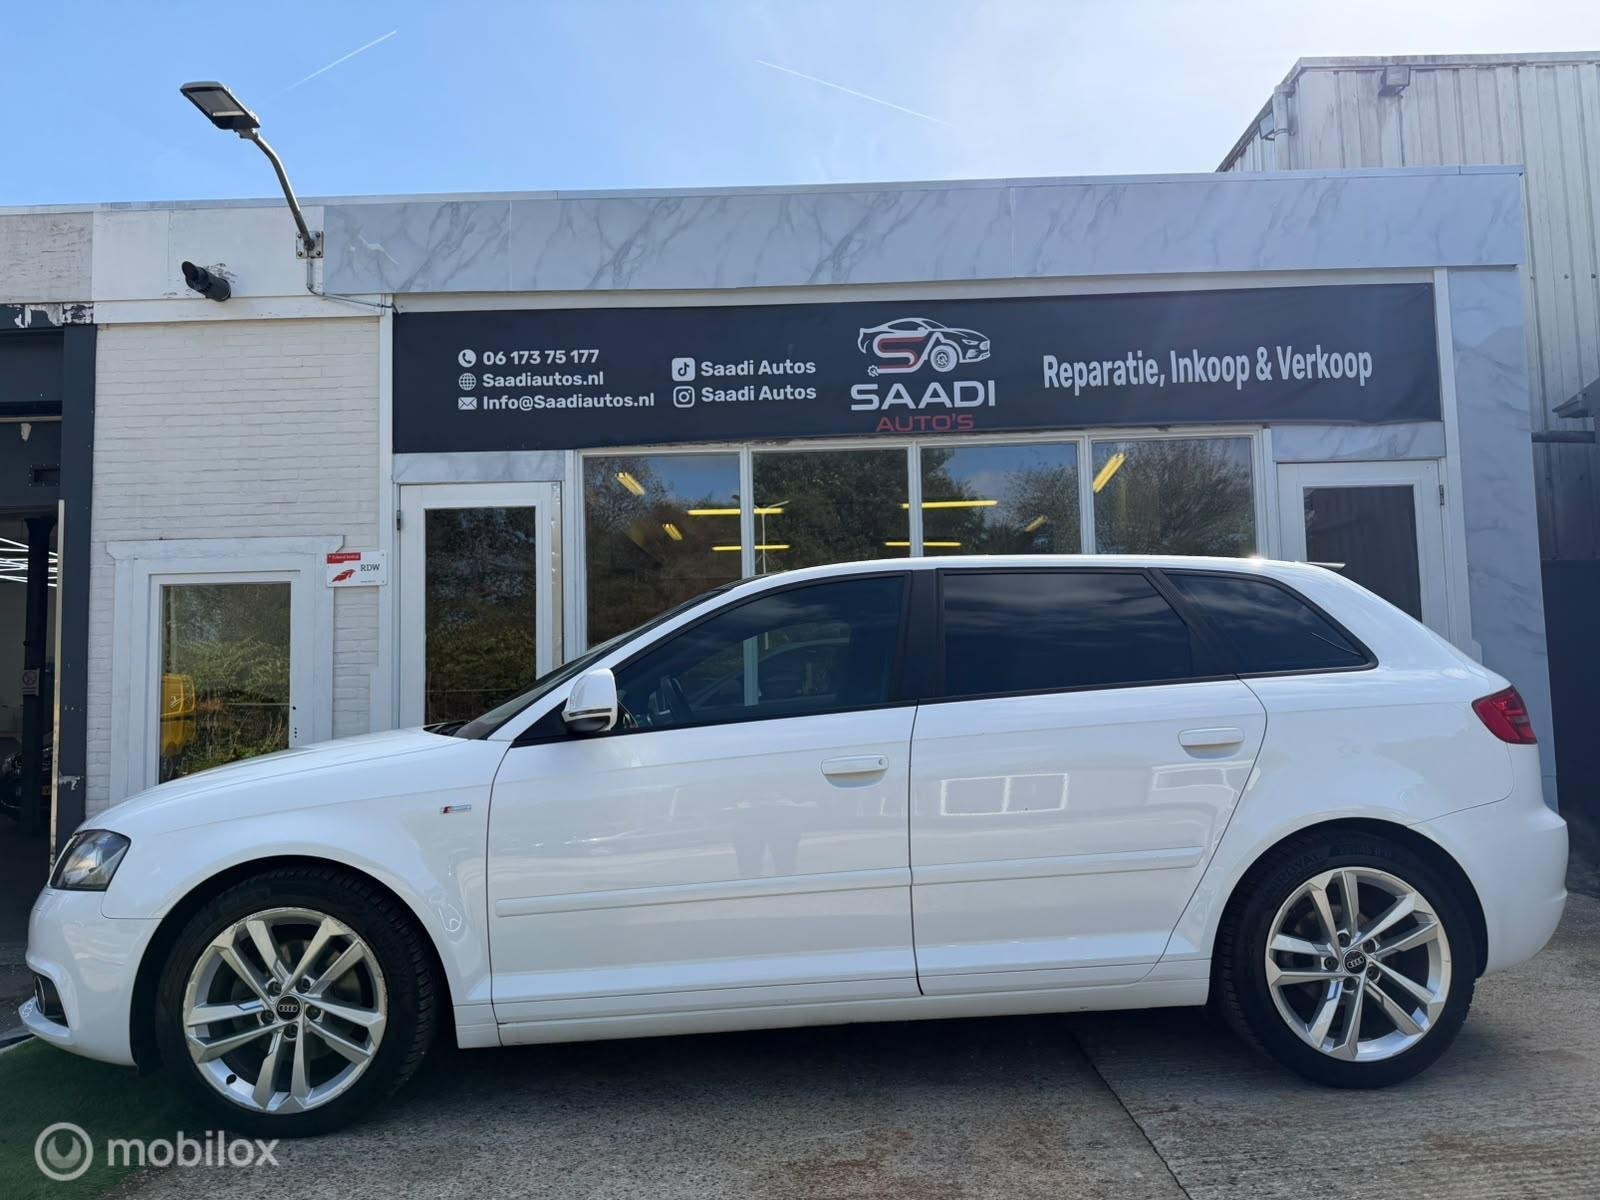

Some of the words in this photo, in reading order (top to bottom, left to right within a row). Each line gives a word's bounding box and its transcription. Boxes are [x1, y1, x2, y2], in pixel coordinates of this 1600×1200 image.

[482, 350, 507, 367] 06
[510, 350, 541, 366] 173
[544, 349, 566, 365] 75
[569, 349, 600, 364] 177
[700, 360, 754, 377] Saadi
[758, 358, 817, 376] Autos
[482, 370, 604, 388] Saadiautos.nl
[1042, 350, 1165, 397] Reparatie,
[1169, 350, 1250, 391] Inkoop
[1255, 346, 1273, 382] &
[1275, 344, 1373, 387] Verkoop
[482, 392, 655, 412] Info@Saadiautos.nl
[700, 385, 755, 404] Saadi
[758, 384, 818, 402] Autos
[850, 379, 996, 411] SAADI
[876, 413, 975, 433] AUTO'S
